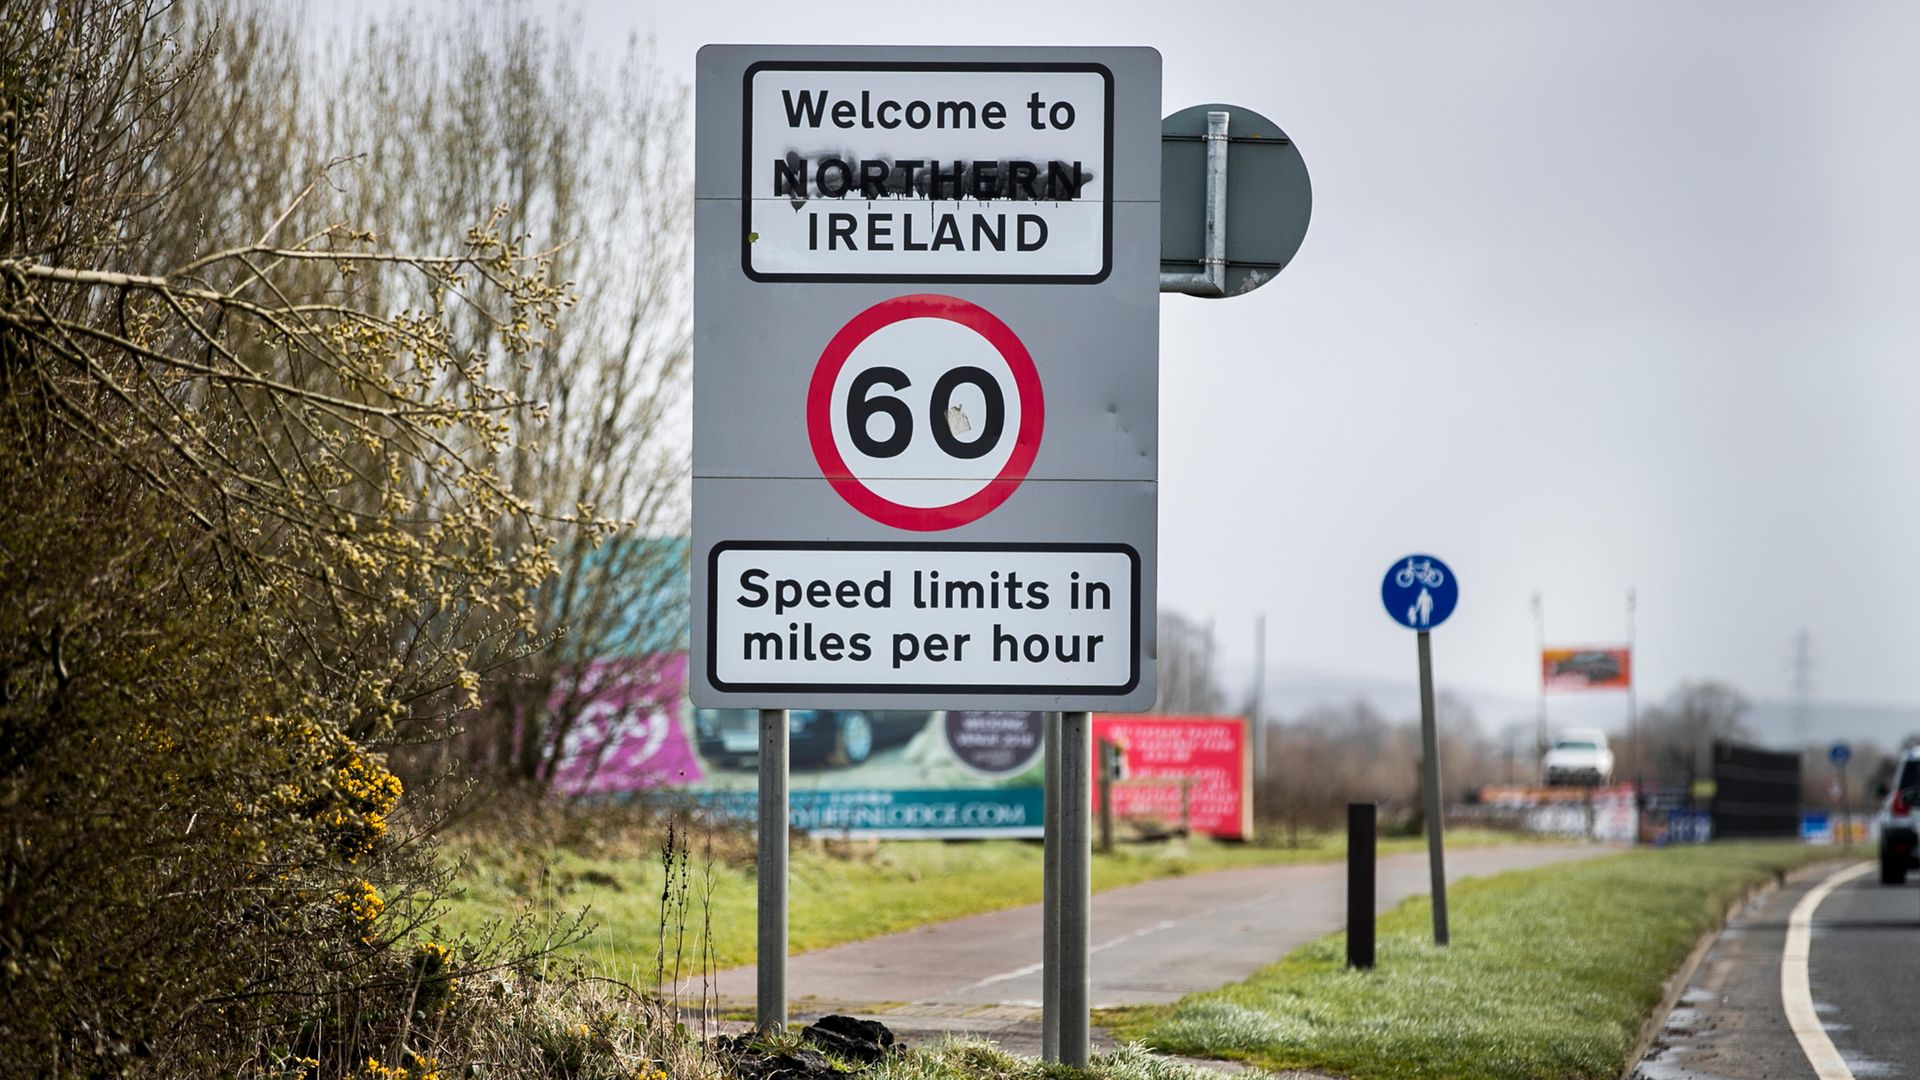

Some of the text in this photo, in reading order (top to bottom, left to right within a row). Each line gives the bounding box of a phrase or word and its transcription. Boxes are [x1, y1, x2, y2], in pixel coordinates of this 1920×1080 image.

[781, 89, 1076, 131] Welcome to
[773, 159, 1082, 199] NORTHERN
[809, 212, 1049, 252] IRELAND
[846, 365, 1005, 460] 60
[736, 568, 1111, 615] Speed limits in
[743, 622, 1104, 669] miles per hour
